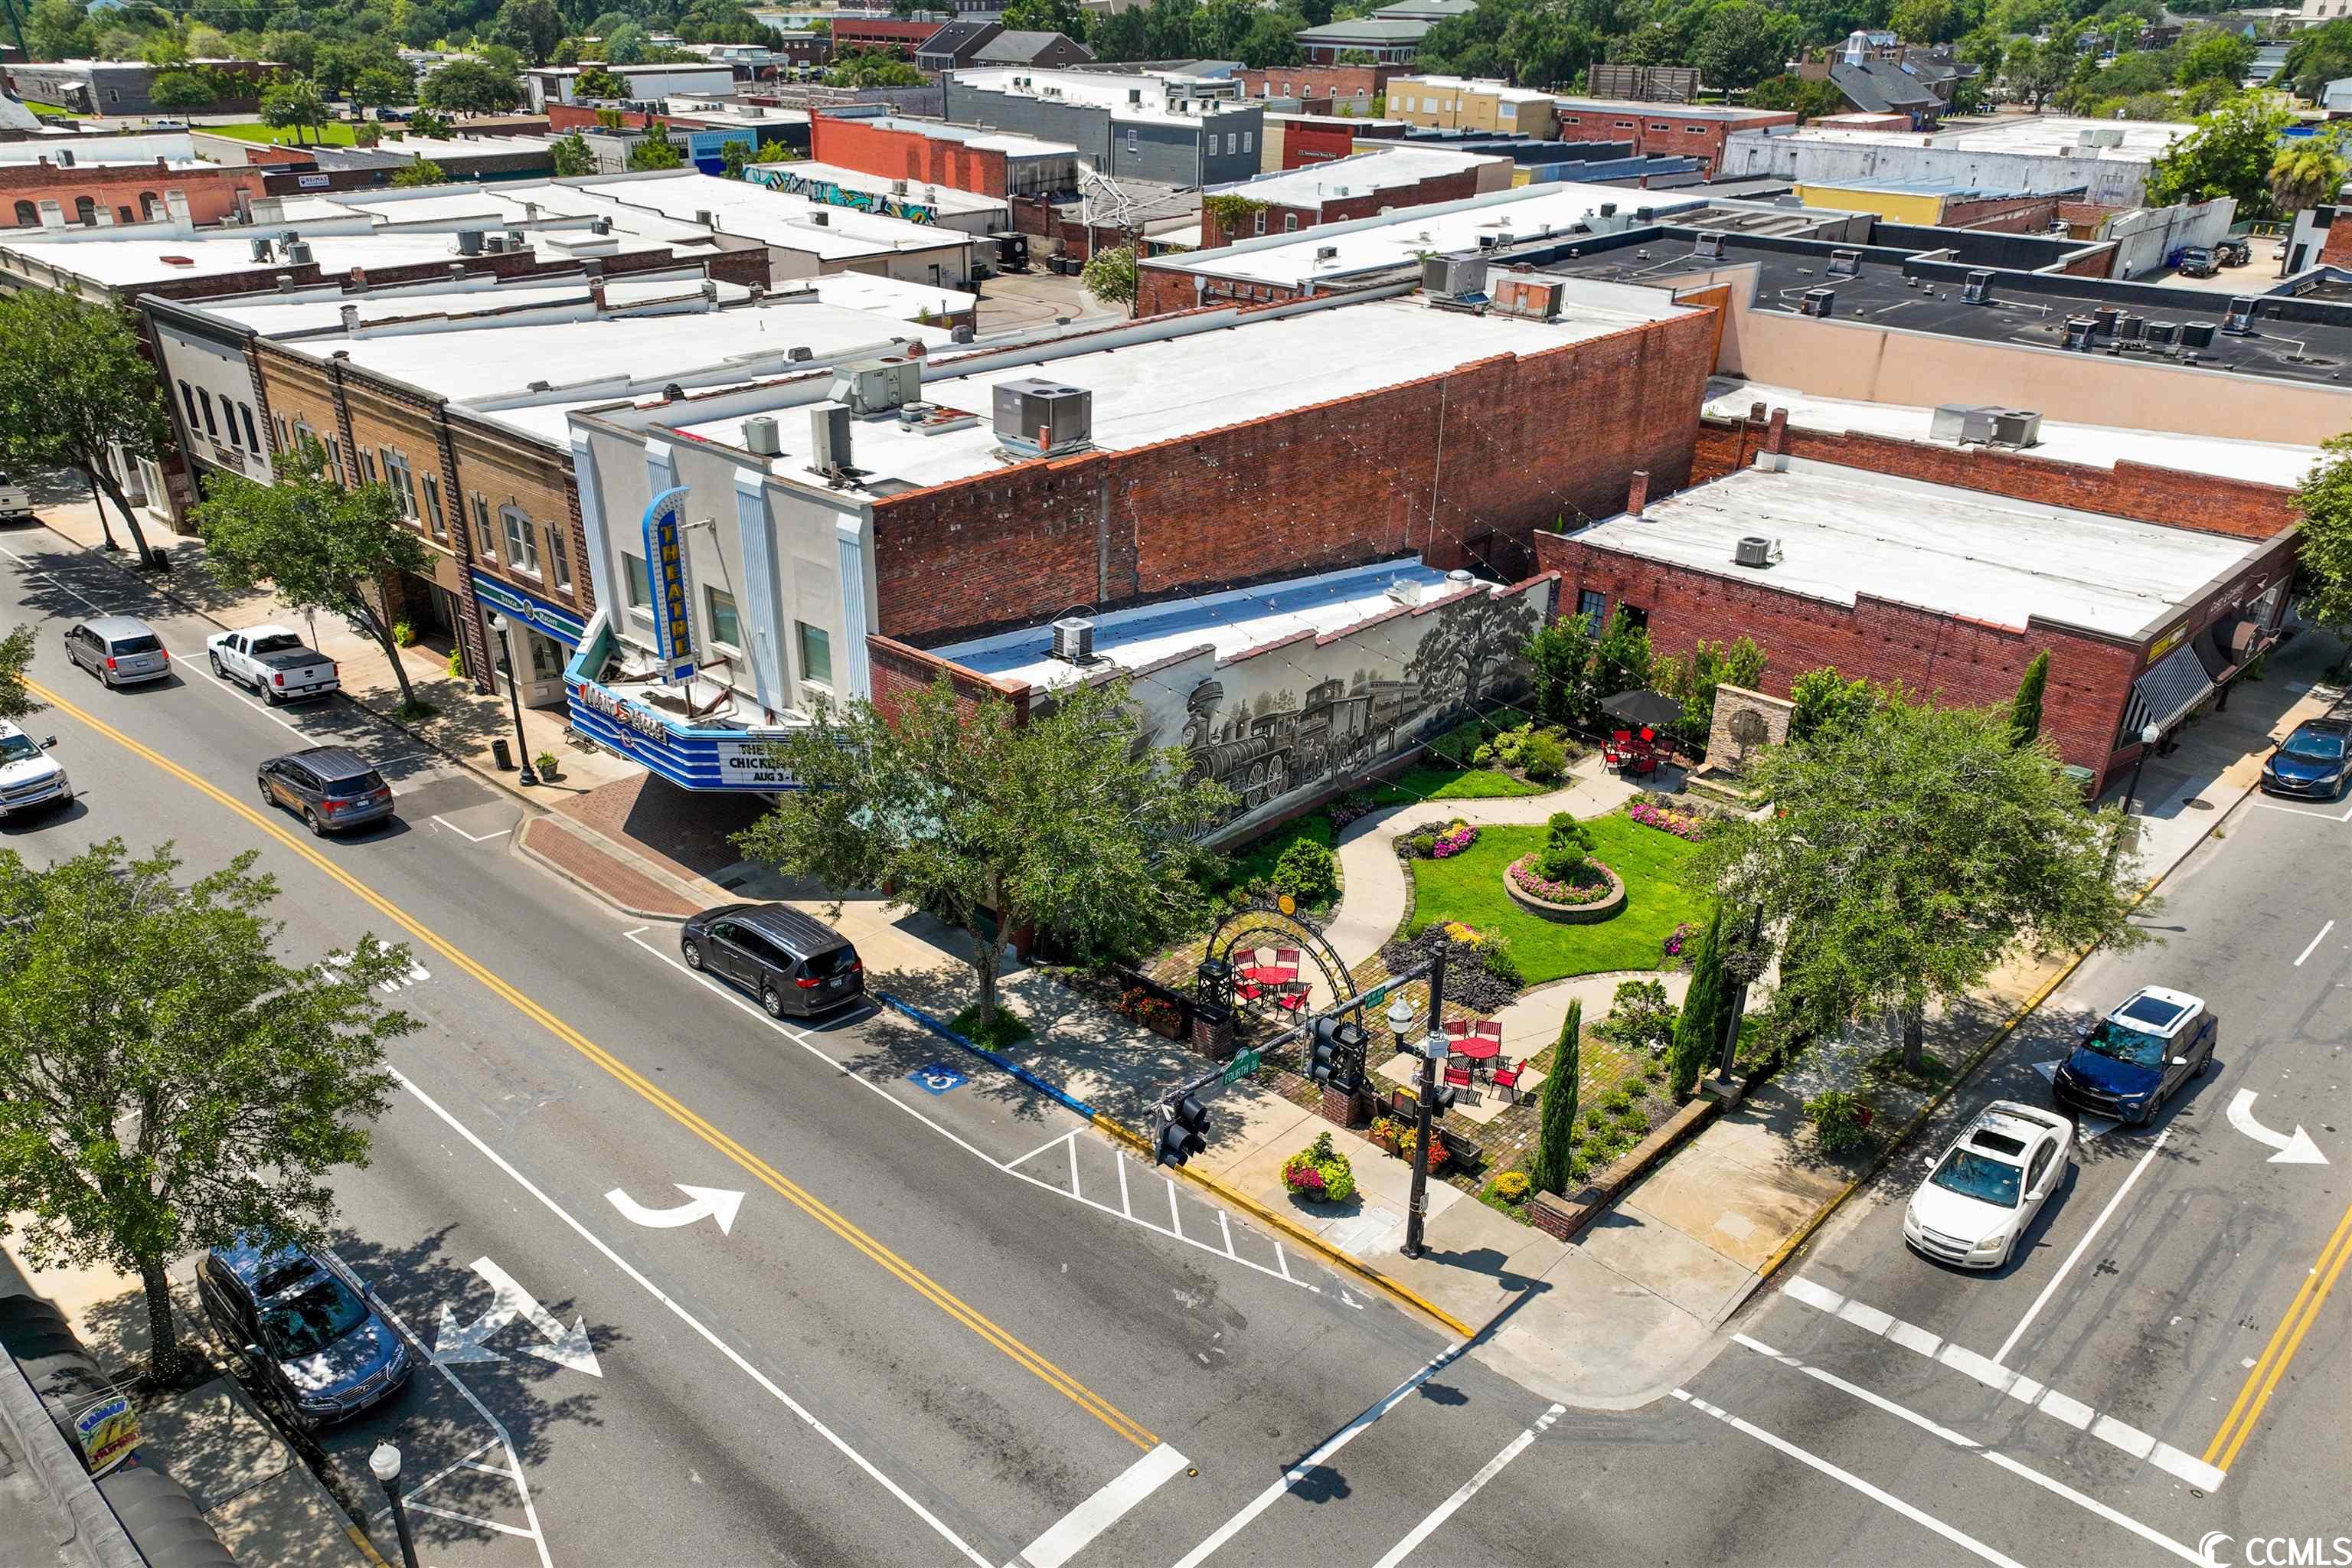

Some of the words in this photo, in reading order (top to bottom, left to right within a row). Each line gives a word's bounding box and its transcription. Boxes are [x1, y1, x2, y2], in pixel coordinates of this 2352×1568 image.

[661, 526, 688, 655] THEATRE
[754, 773, 775, 781] AUG
[1225, 1063, 1249, 1084] FOURTH
